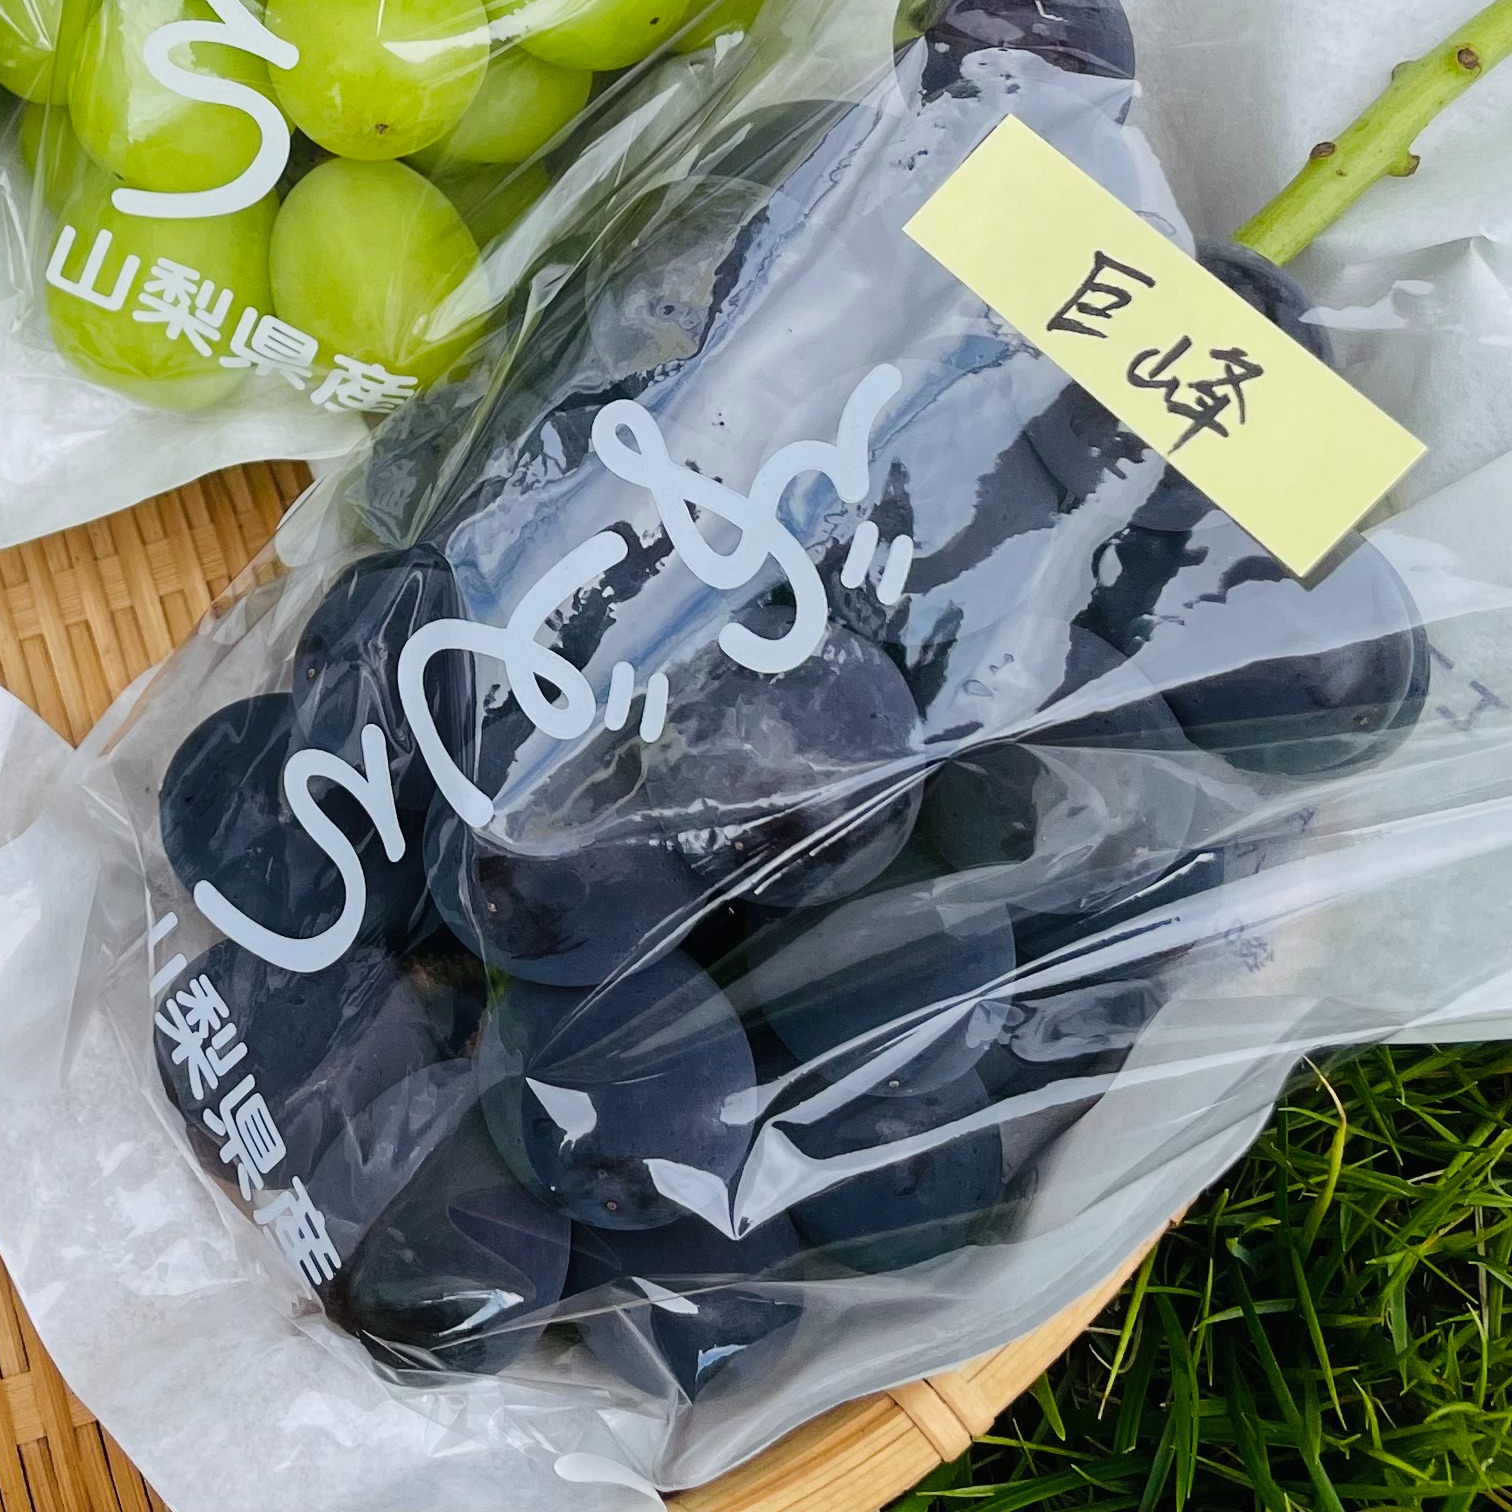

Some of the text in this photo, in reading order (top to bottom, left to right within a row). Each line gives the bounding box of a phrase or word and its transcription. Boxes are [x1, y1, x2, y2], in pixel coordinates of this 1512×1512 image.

[45, 224, 419, 415] 山梨県産
[1047, 251, 1264, 455] 巨峰
[194, 363, 913, 973] ぶどう
